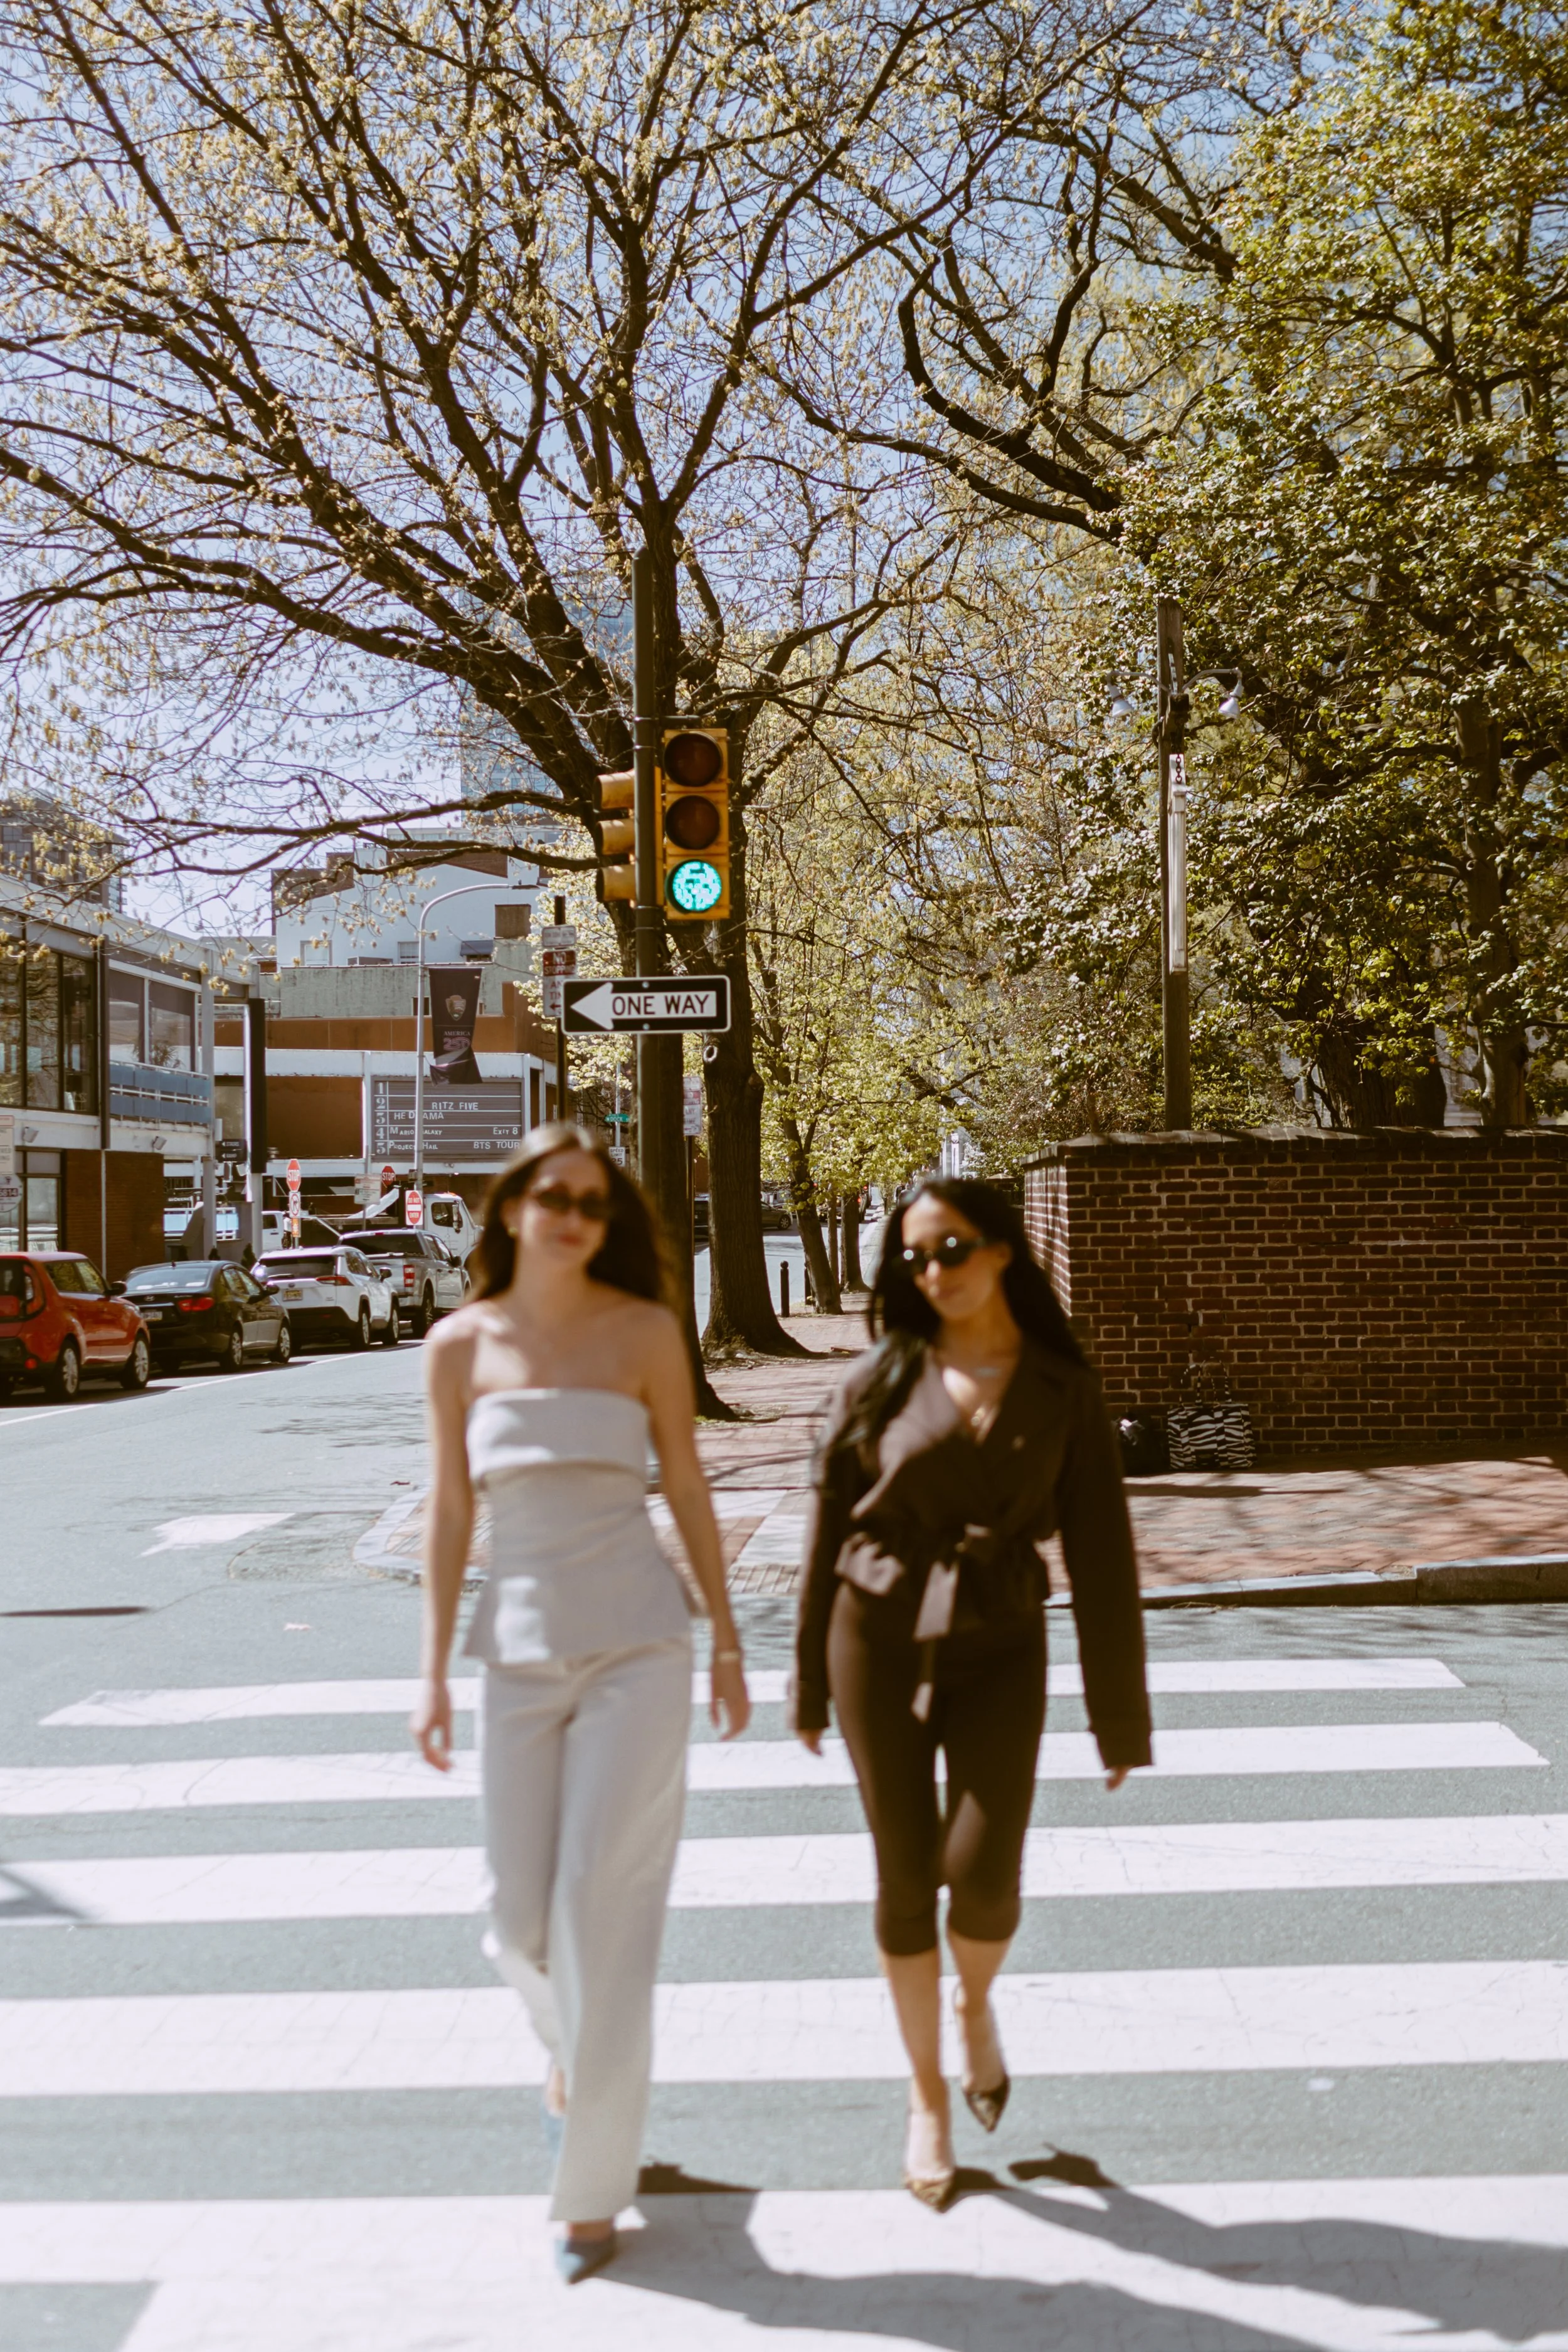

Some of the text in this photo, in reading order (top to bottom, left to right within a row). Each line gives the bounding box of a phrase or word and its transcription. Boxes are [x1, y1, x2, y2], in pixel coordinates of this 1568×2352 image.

[553, 951, 566, 965] NO
[612, 993, 710, 1015] ONE WAY
[443, 1037, 471, 1051] 250
[378, 1083, 384, 1094] 1
[376, 1098, 386, 1109] 2
[432, 1102, 479, 1110] RITZ FIVE
[409, 1111, 444, 1120] DAMA
[376, 1127, 384, 1139] 4
[376, 1142, 386, 1155] 5
[496, 1141, 520, 1149] TOUR
[288, 1170, 300, 1182] STOP
[382, 1172, 395, 1180] STOP
